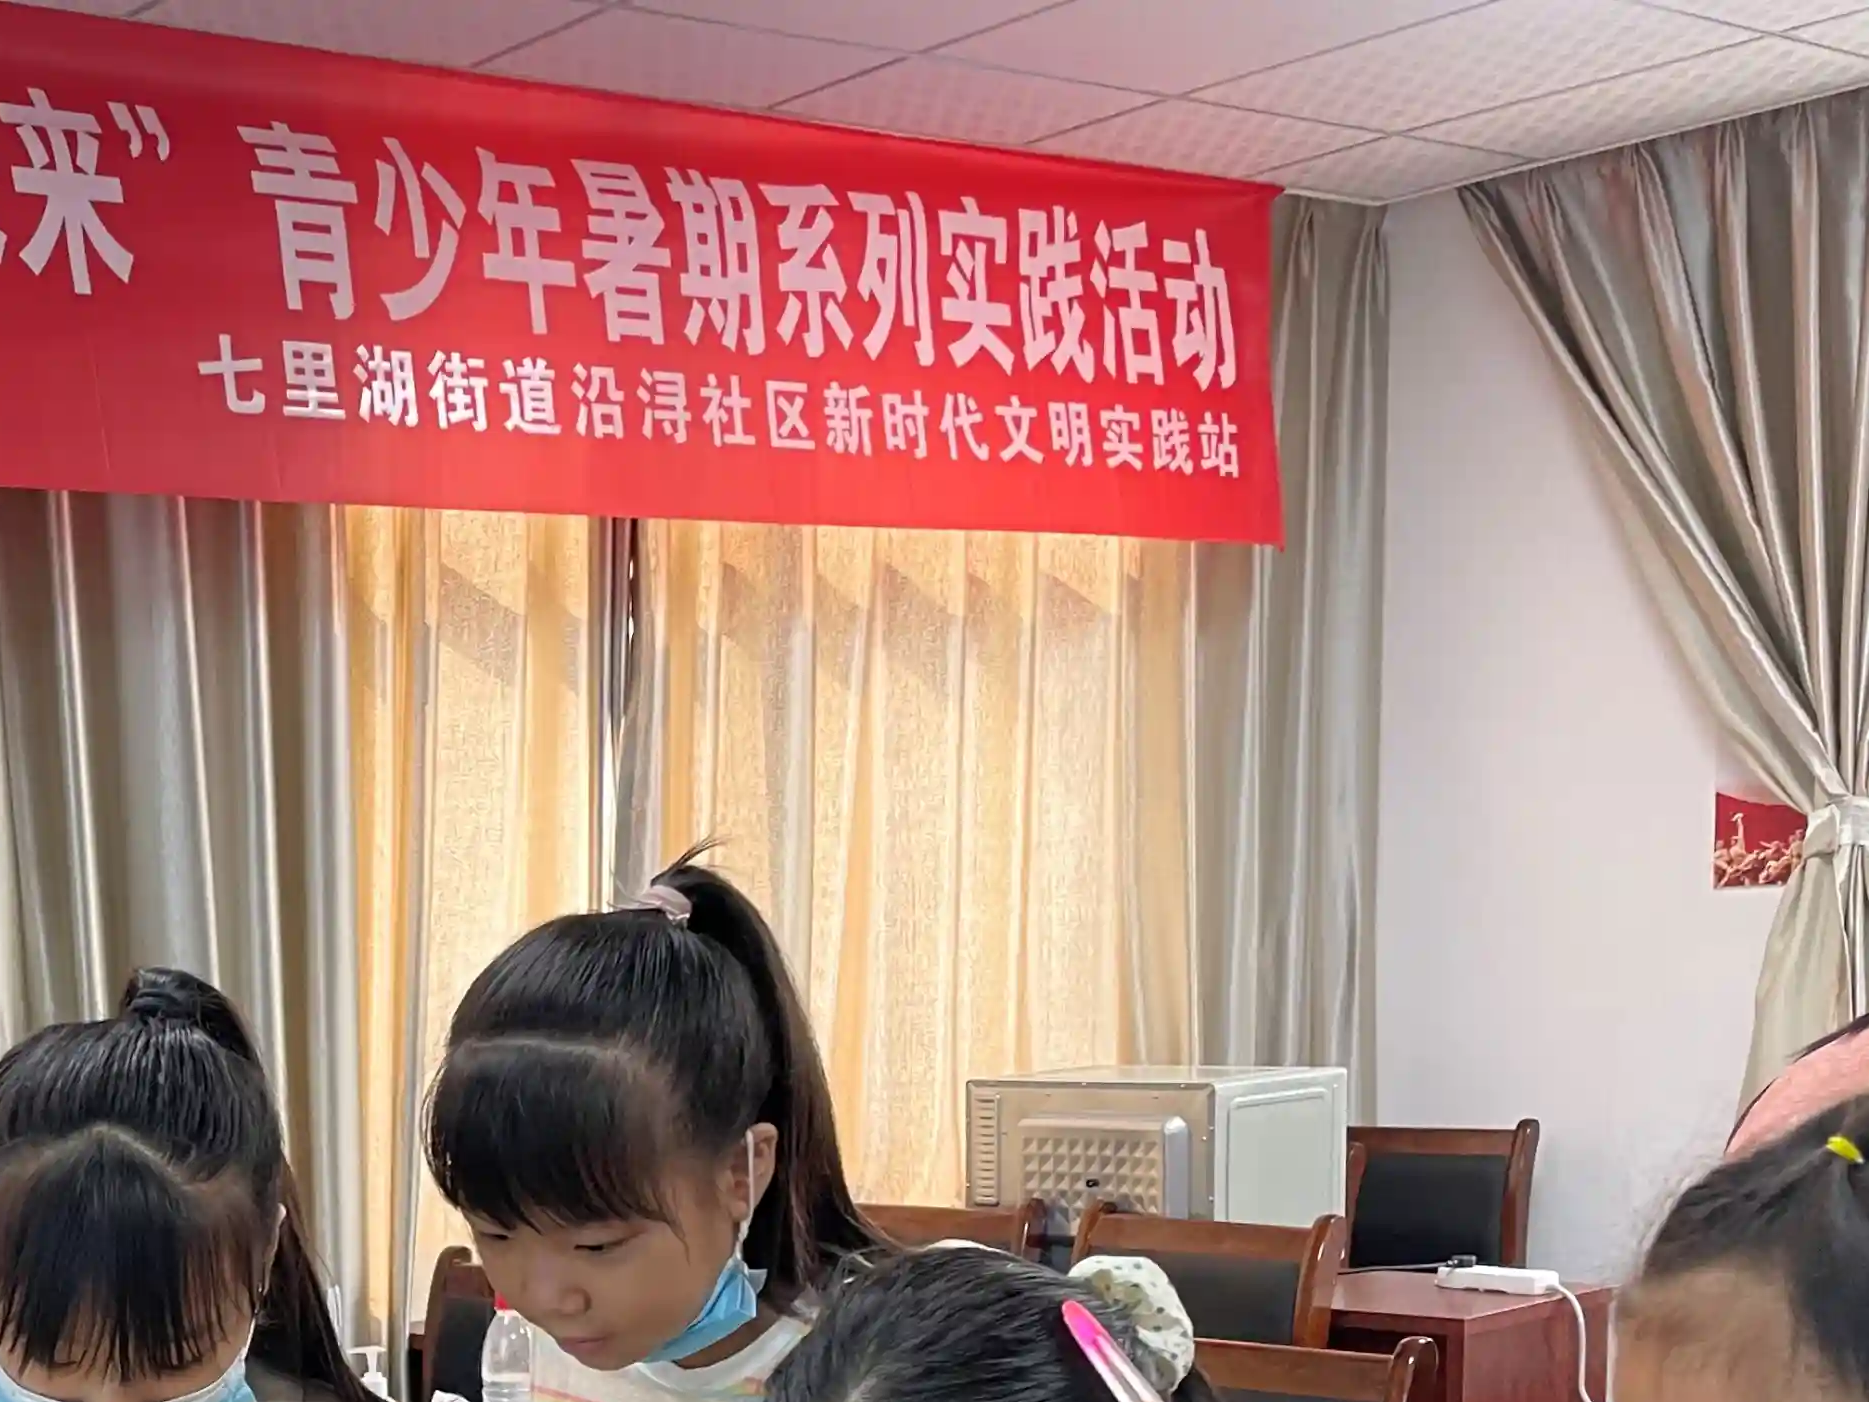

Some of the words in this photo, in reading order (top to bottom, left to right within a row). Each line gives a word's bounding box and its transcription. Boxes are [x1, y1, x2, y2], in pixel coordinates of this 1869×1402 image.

[236, 121, 1238, 392] 青少年暑期系列实践活动
[197, 332, 1241, 479] 七里湖街道沿浔社区新时代文明实践站
